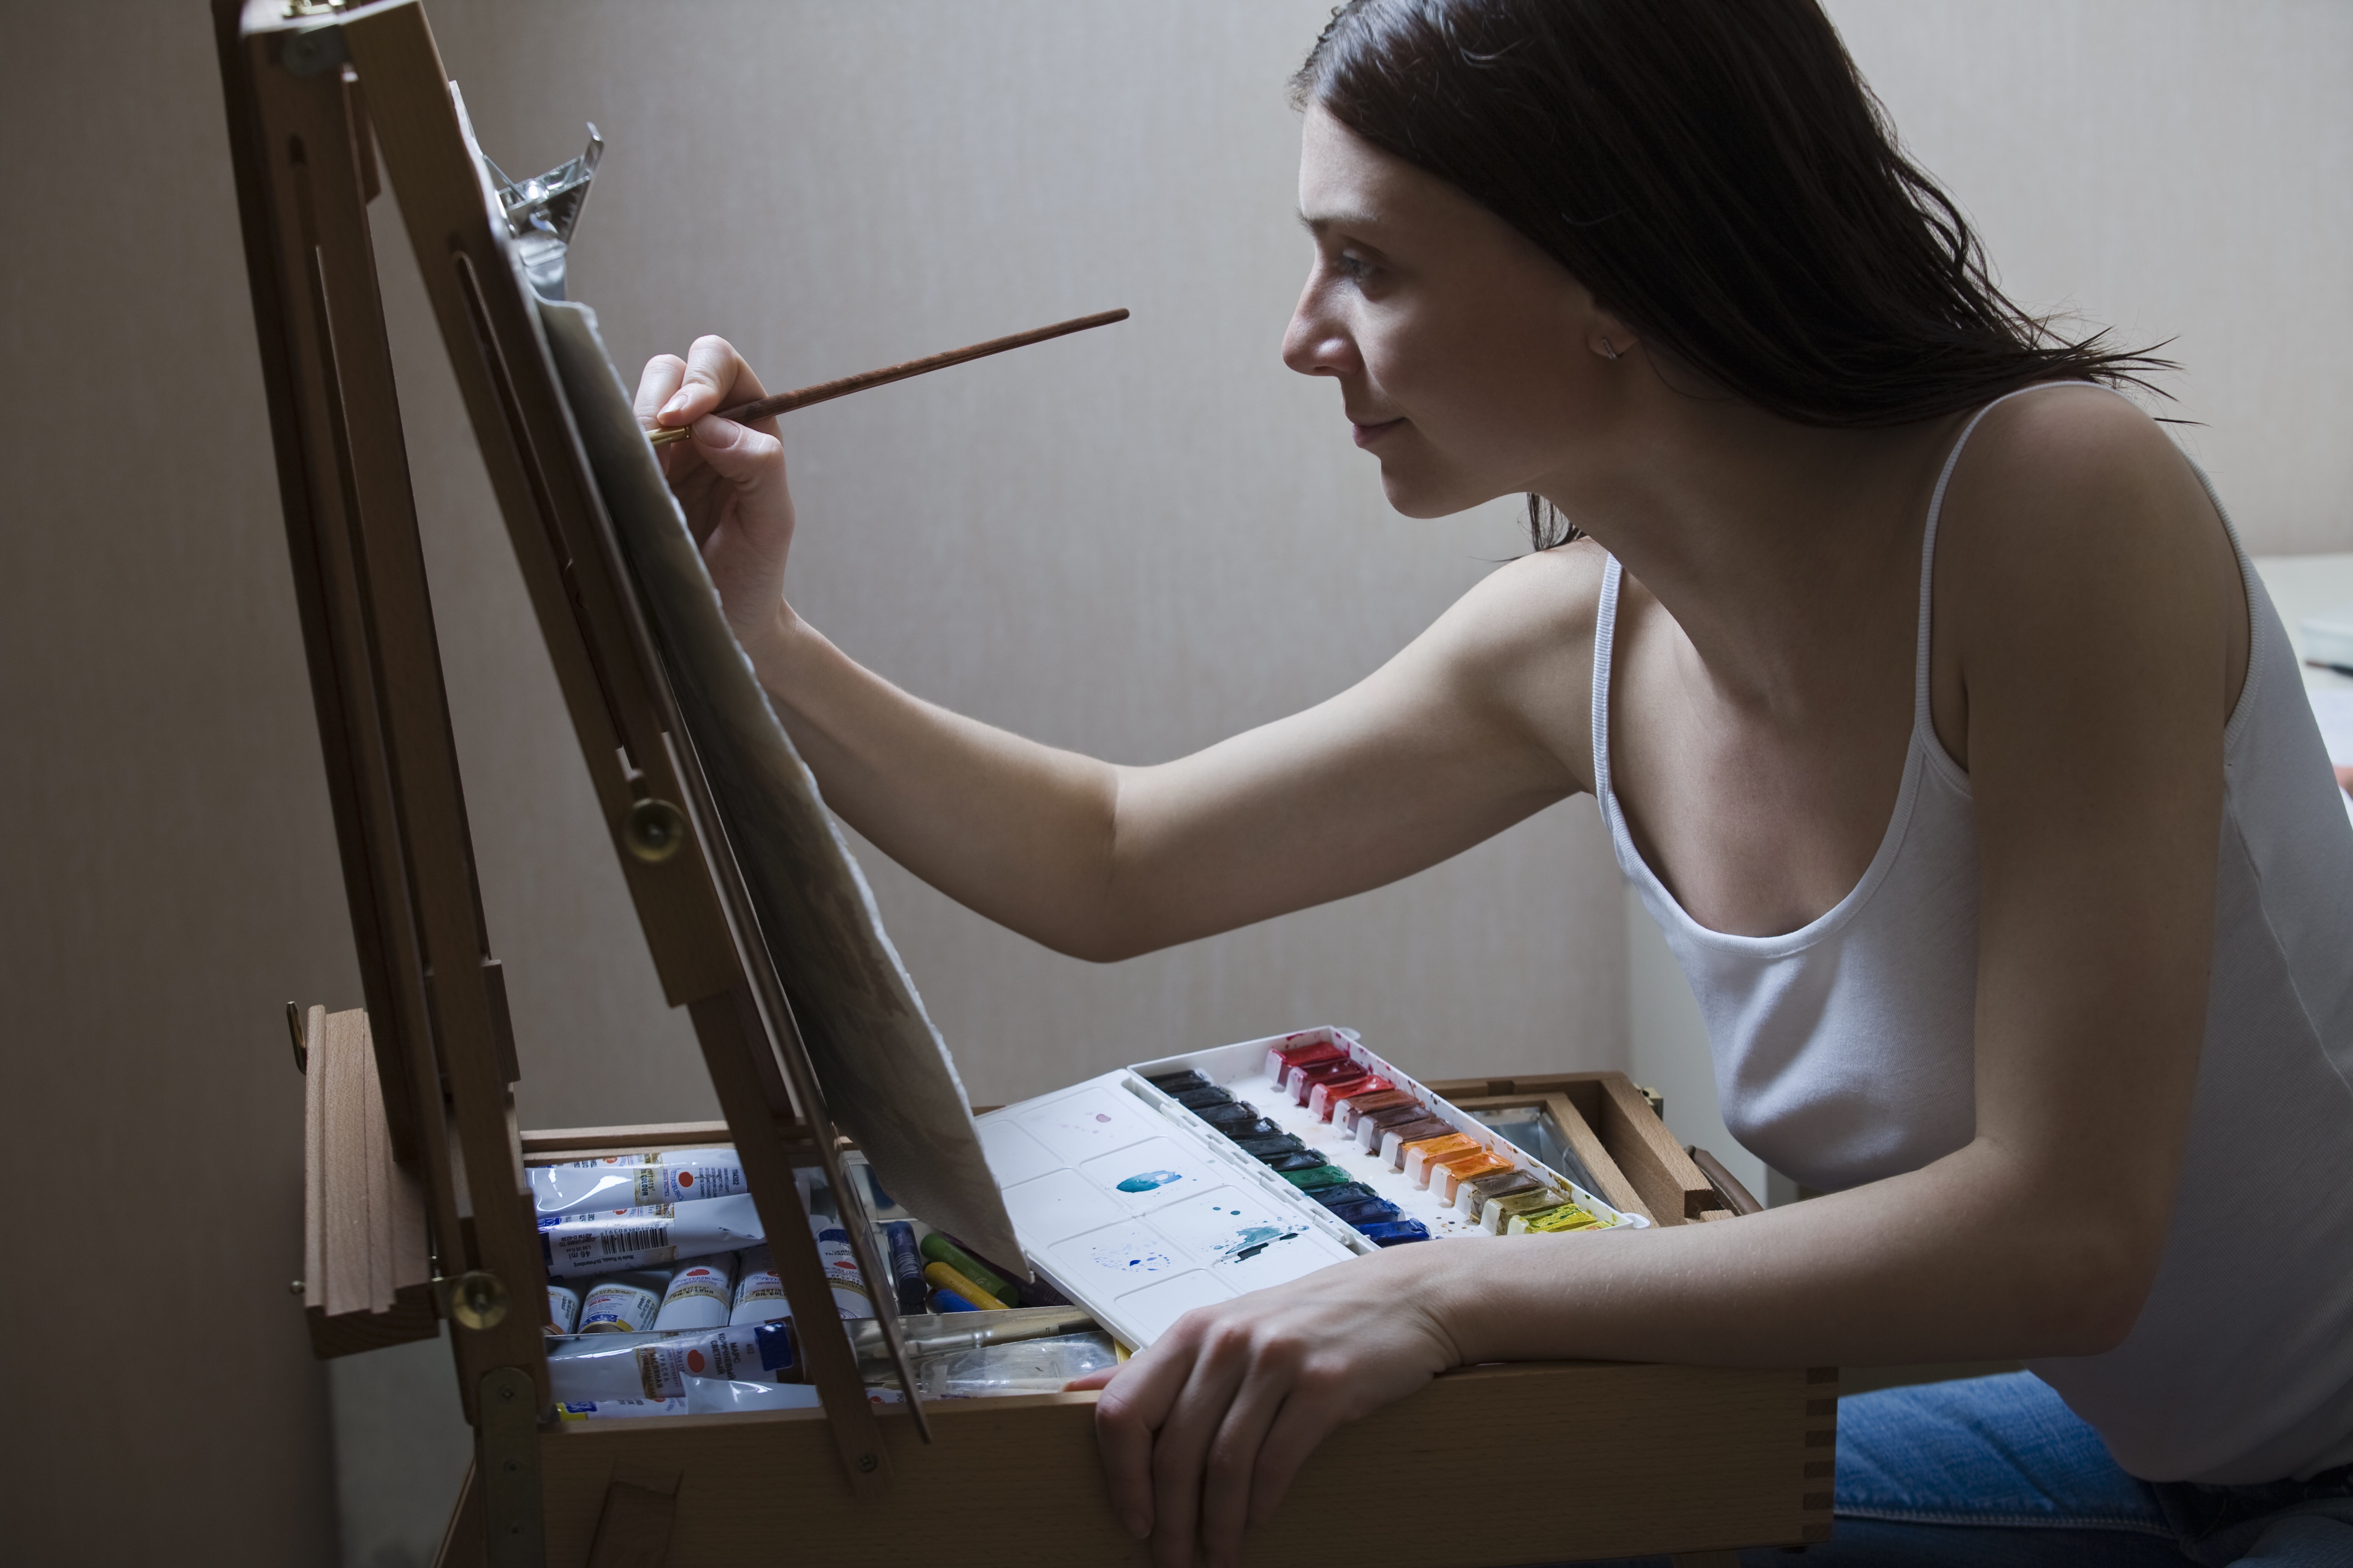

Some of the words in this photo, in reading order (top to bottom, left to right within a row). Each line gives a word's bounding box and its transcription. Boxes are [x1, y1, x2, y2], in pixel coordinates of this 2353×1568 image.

[567, 1237, 595, 1245] CONFORMS
[711, 1340, 725, 1375] СВЕТЛЫЙ
[718, 1333, 737, 1380] КОРИЧНЕВЫЙ
[730, 1342, 741, 1364] МАРС
[746, 1343, 755, 1355] 402
[649, 1351, 663, 1388] МАСЛЯНАЯ
[659, 1354, 670, 1382] КРАСКА
